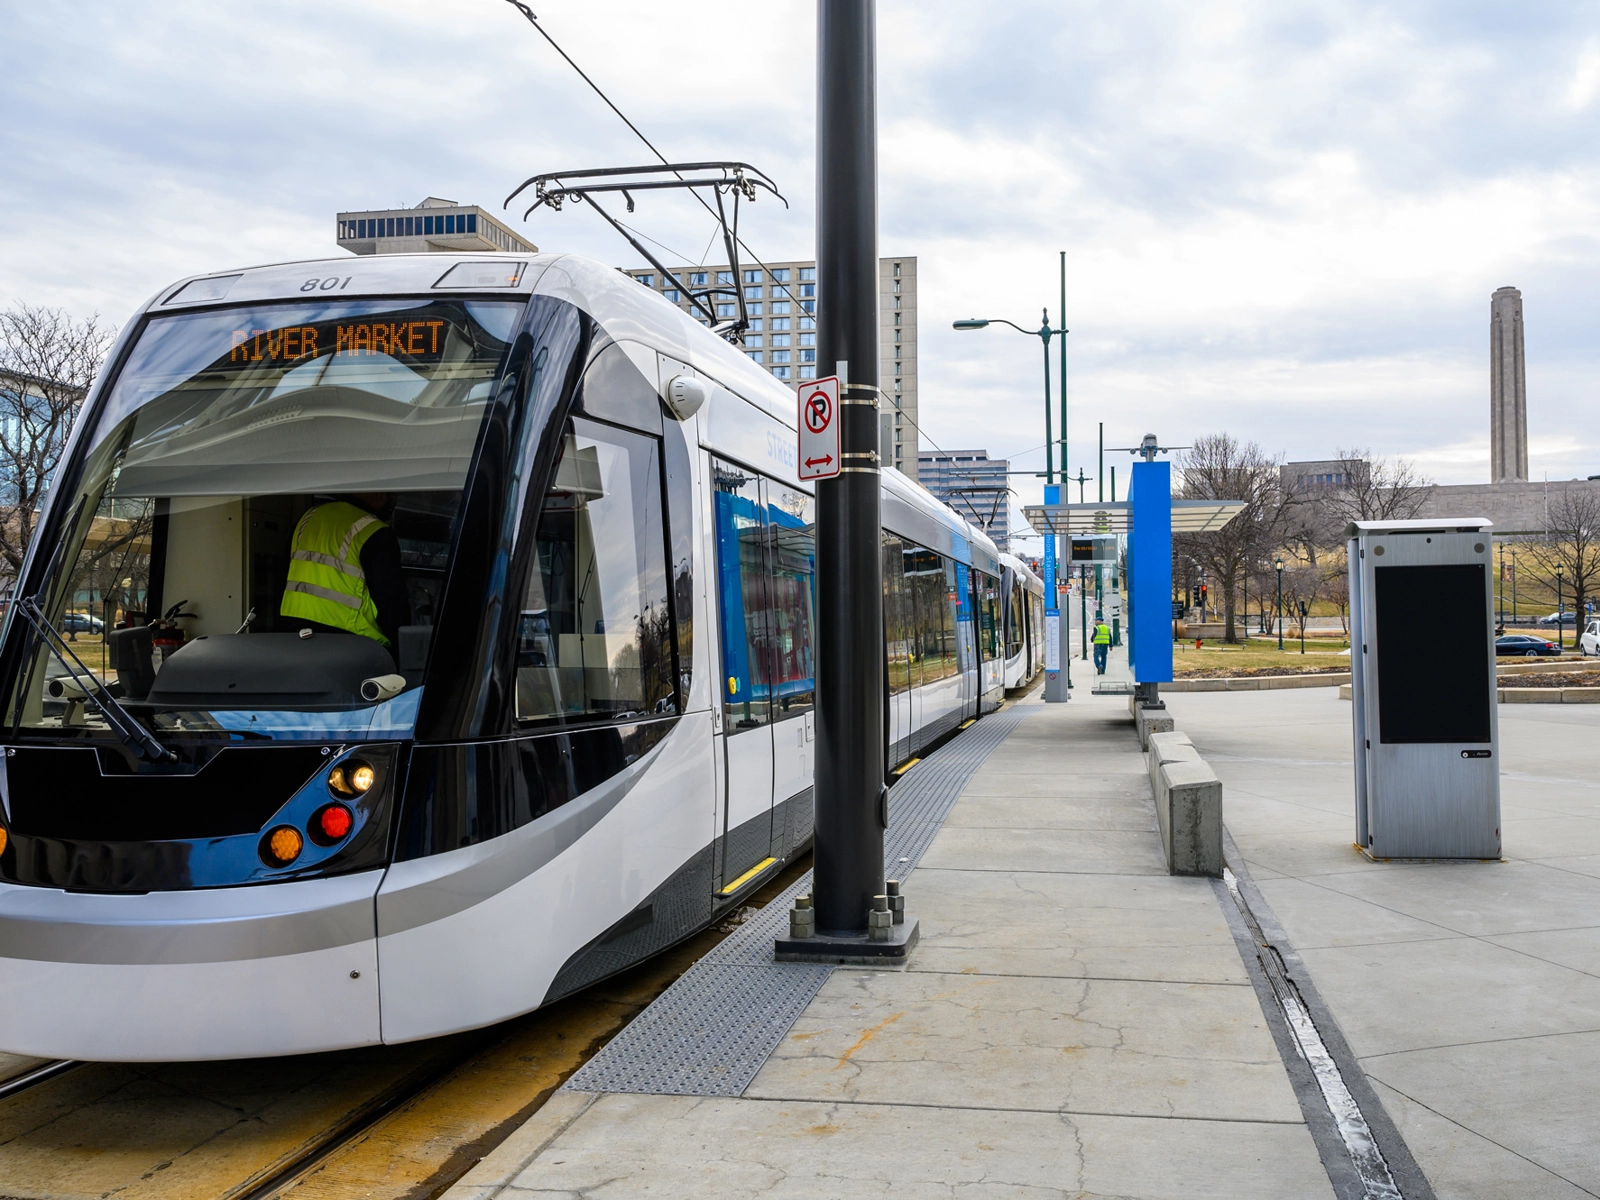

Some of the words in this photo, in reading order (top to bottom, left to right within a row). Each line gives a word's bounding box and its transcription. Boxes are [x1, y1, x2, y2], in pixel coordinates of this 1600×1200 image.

[300, 276, 353, 292] 801
[231, 328, 318, 361] RIVER
[336, 321, 444, 357] MARKET
